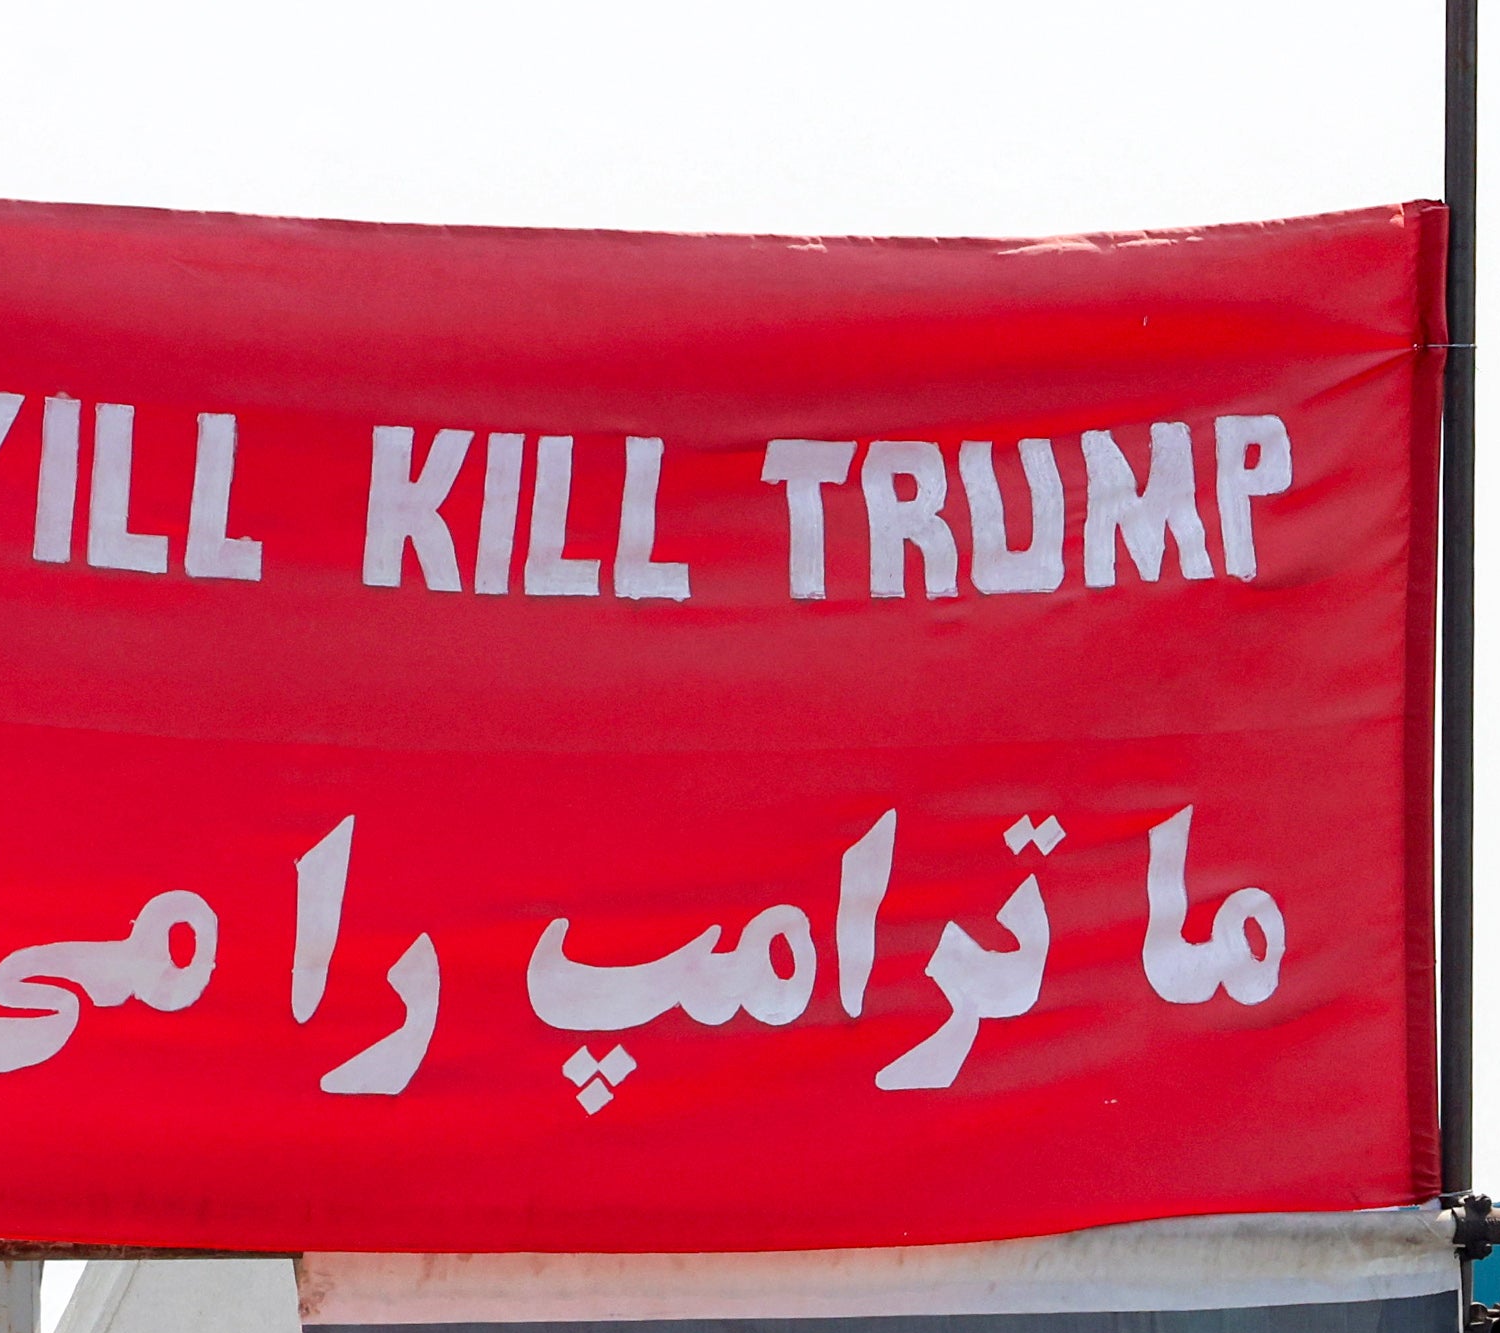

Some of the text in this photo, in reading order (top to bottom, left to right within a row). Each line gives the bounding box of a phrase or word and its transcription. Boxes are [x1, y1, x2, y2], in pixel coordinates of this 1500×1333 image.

[361, 424, 693, 603] KILL
[759, 413, 1294, 601] TRUMP
[290, 813, 442, 1096] را
[525, 807, 1067, 1116] ترامپ
[1141, 803, 1287, 1007] ما
